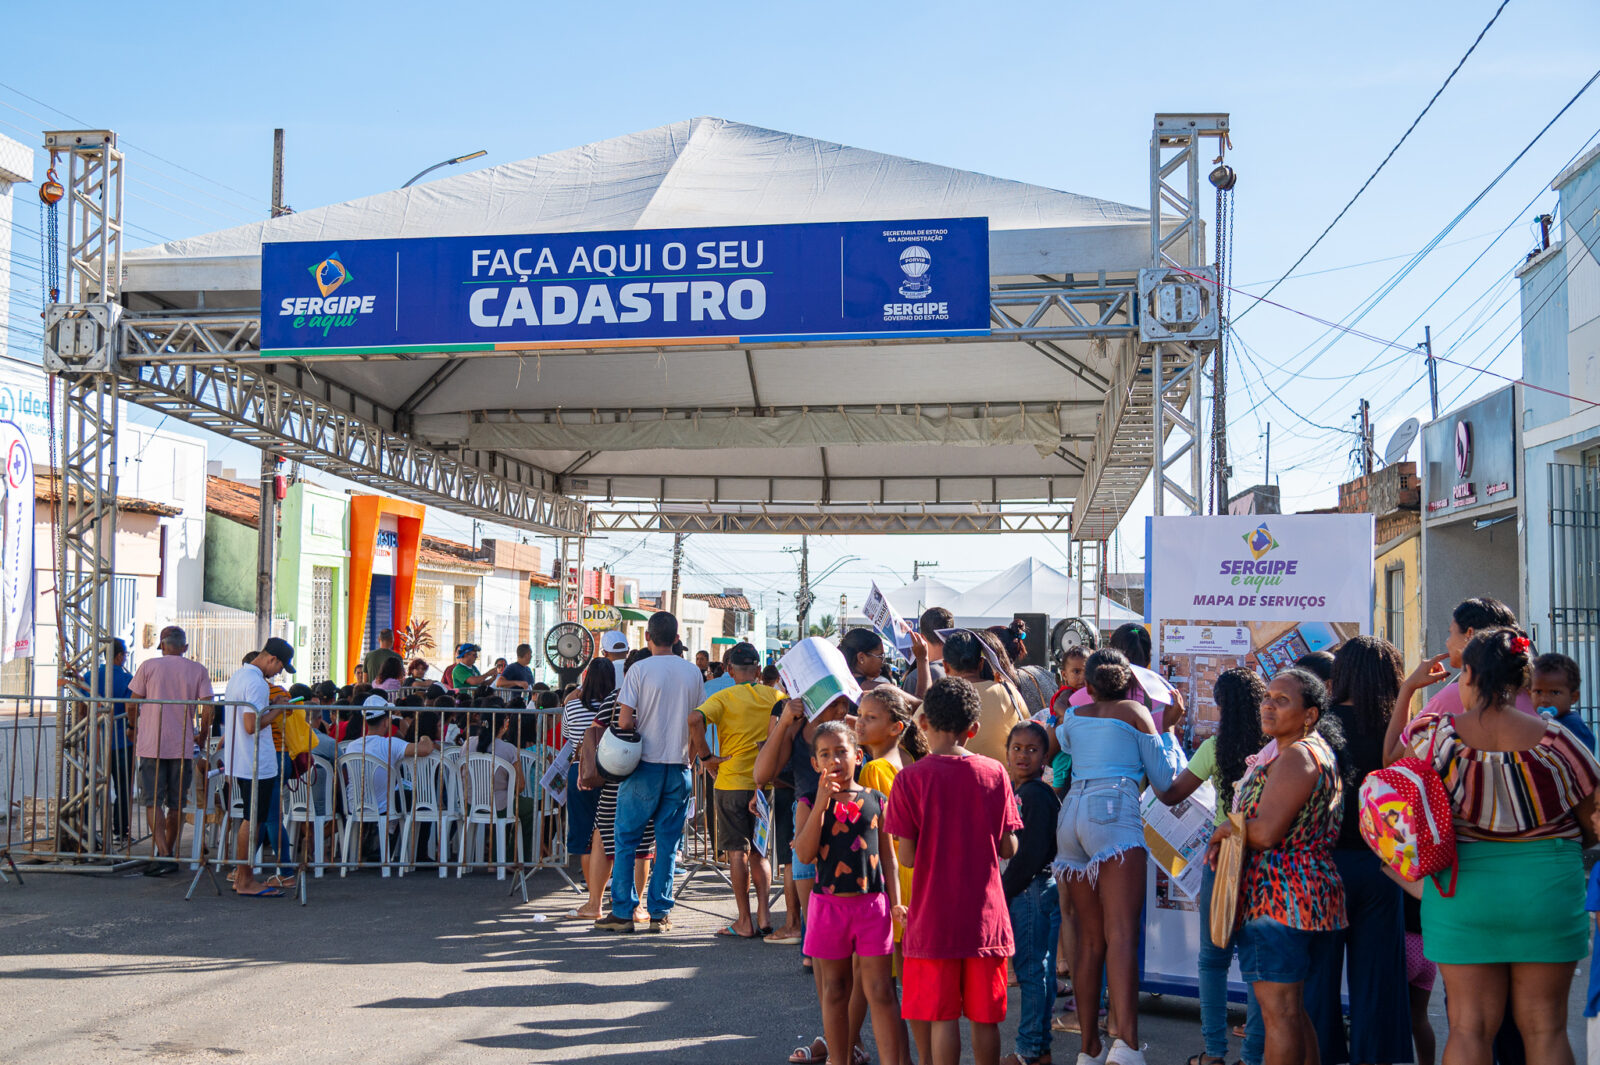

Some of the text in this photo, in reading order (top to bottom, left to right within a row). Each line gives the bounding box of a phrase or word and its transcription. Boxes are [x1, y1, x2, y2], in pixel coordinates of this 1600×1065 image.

[897, 235, 943, 243] ADMINISTRAÇÃO
[472, 240, 764, 283] FAÇA AQUI O SEU
[279, 295, 377, 316] SERGIPE
[469, 279, 767, 327] CADASTRO
[883, 302, 948, 315] SERGIPE
[308, 308, 358, 337] aqui
[1453, 483, 1471, 499] PORTAL
[1219, 560, 1299, 576] SERGIPE
[1243, 570, 1284, 594] aqui
[1193, 594, 1326, 610] MAPA DE SERVIÇOS
[583, 610, 614, 620] DIDA
